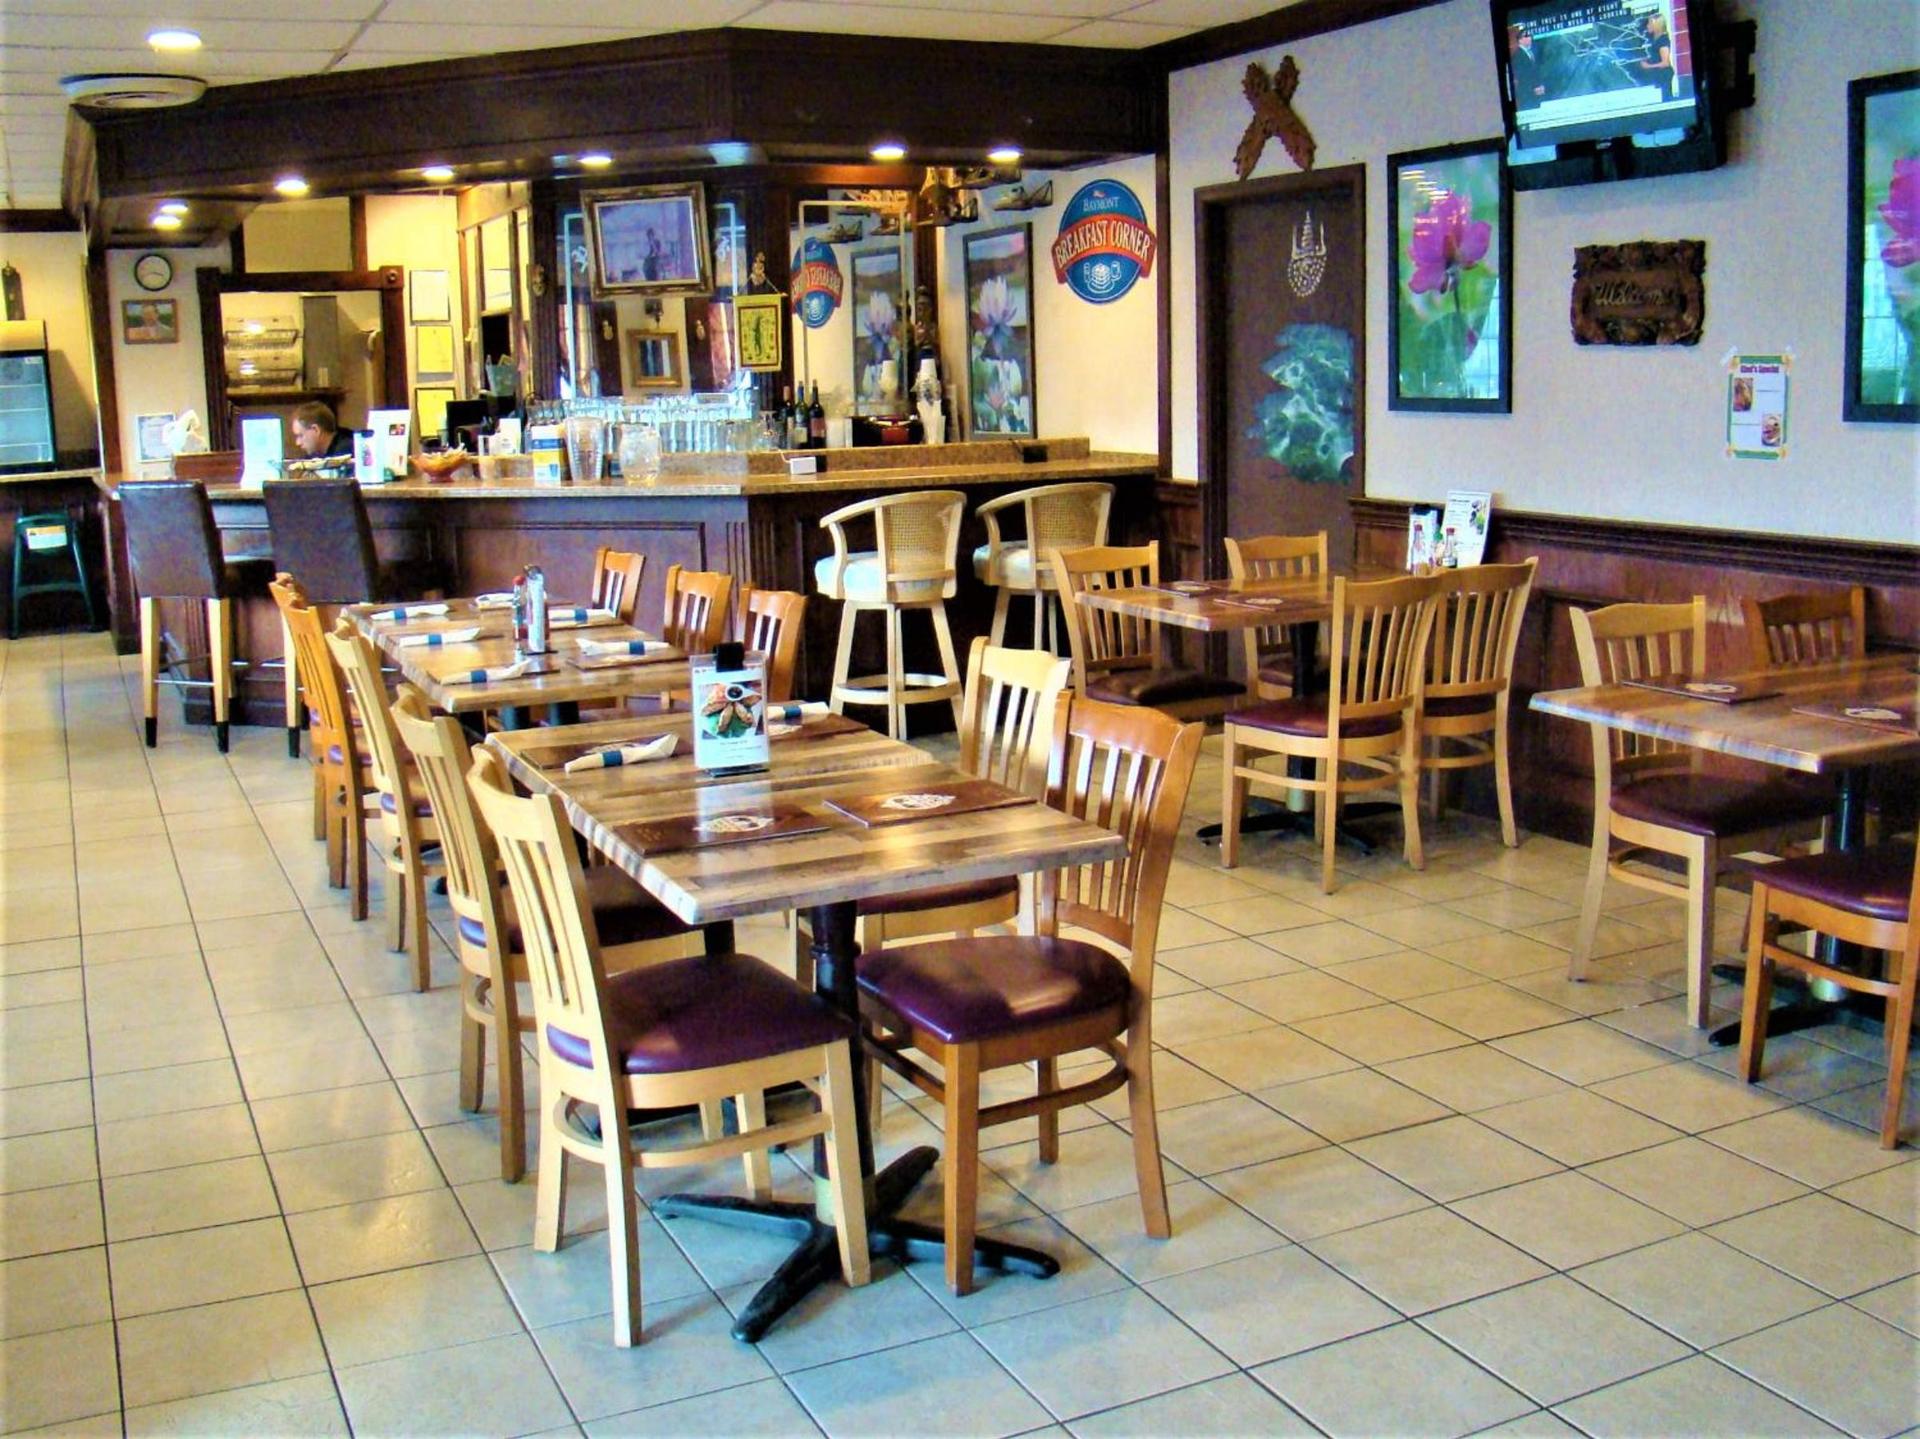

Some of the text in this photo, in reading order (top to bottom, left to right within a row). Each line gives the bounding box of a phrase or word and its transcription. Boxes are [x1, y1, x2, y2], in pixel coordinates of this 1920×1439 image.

[1083, 197, 1119, 212] BAYMONT
[1055, 220, 1151, 269] BREAKFAST CORNER
